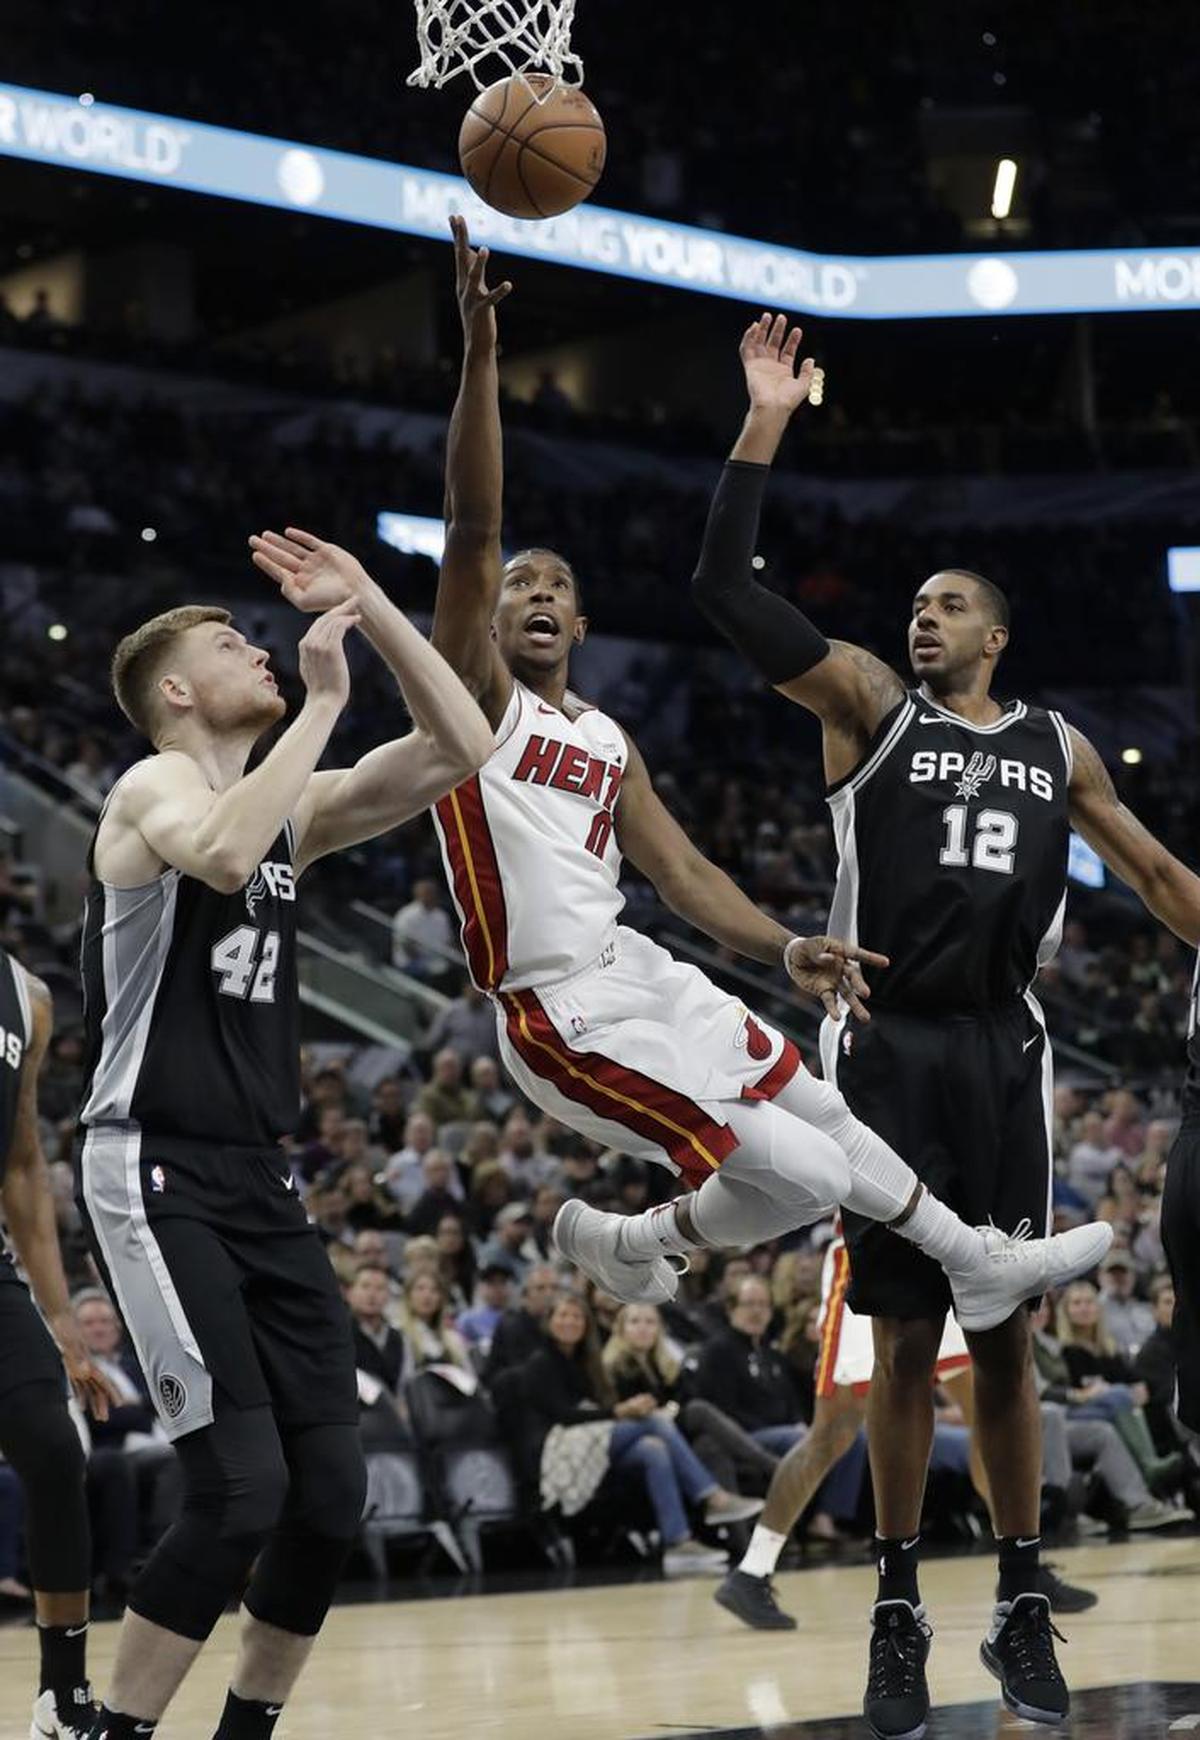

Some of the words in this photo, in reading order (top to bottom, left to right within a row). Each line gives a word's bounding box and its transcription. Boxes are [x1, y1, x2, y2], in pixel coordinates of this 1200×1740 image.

[19, 100, 182, 174] WORLD
[620, 221, 725, 284] YOUR
[724, 246, 857, 309] WORLD
[511, 733, 622, 812] HEAT
[939, 804, 1019, 875] 12
[211, 923, 280, 1003] 42
